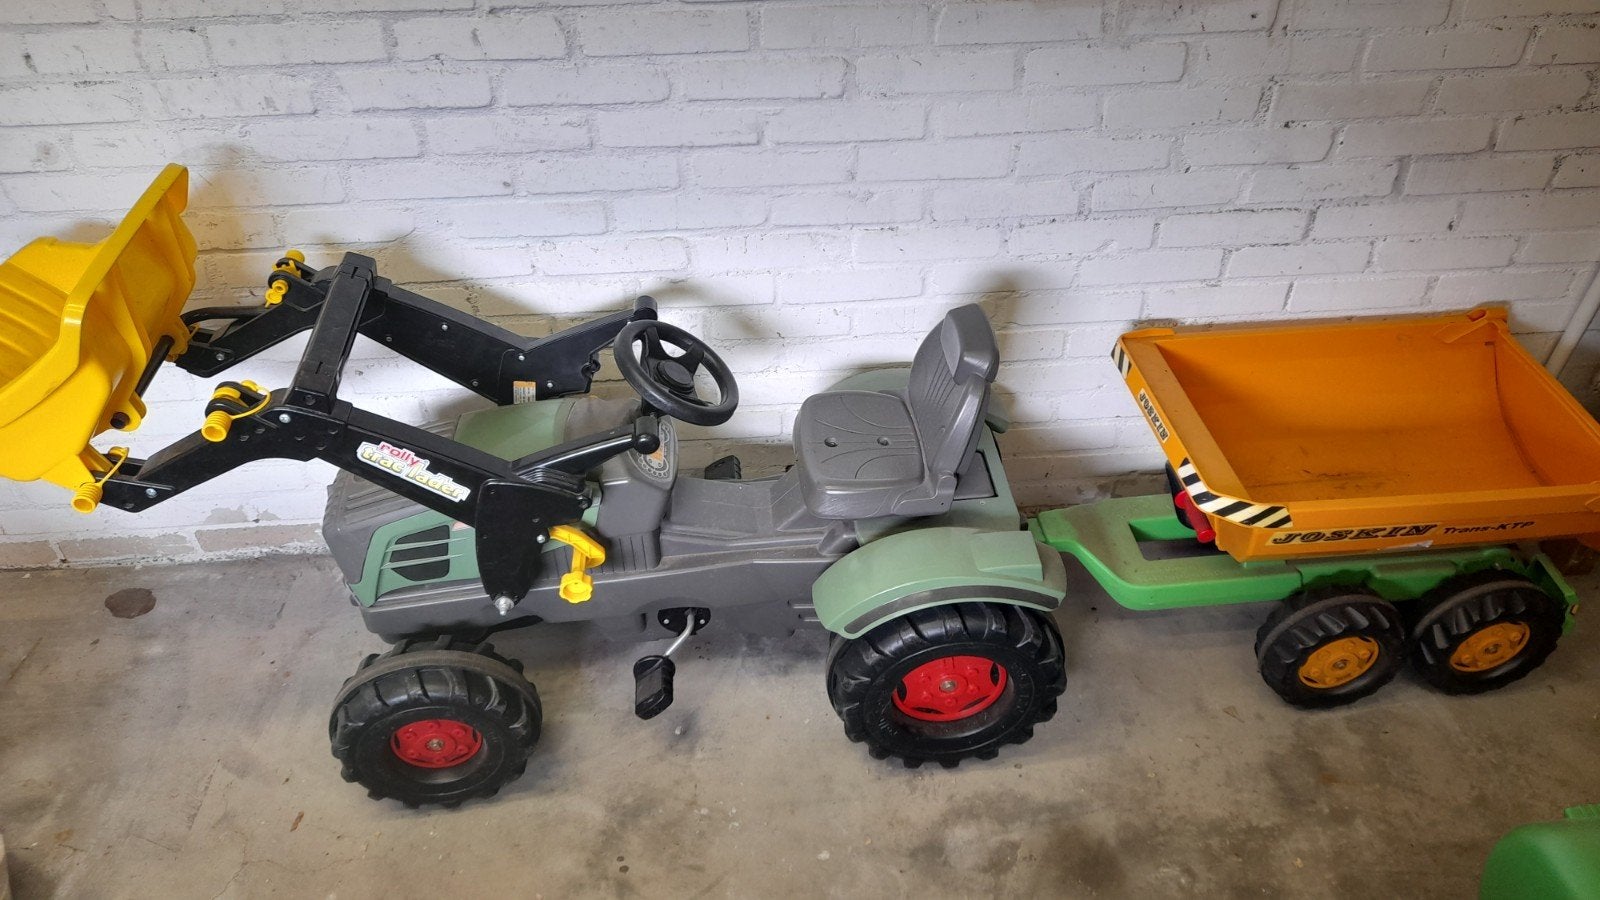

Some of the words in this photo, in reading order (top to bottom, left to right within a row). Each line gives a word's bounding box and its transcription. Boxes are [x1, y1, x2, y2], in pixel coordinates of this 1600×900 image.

[1139, 393, 1169, 441] JOSKIN
[361, 446, 406, 474] trac
[406, 462, 462, 499] lader
[380, 443, 420, 467] rolly
[1272, 523, 1438, 545] JOSKIN
[1444, 521, 1536, 534] Trans-KTP
